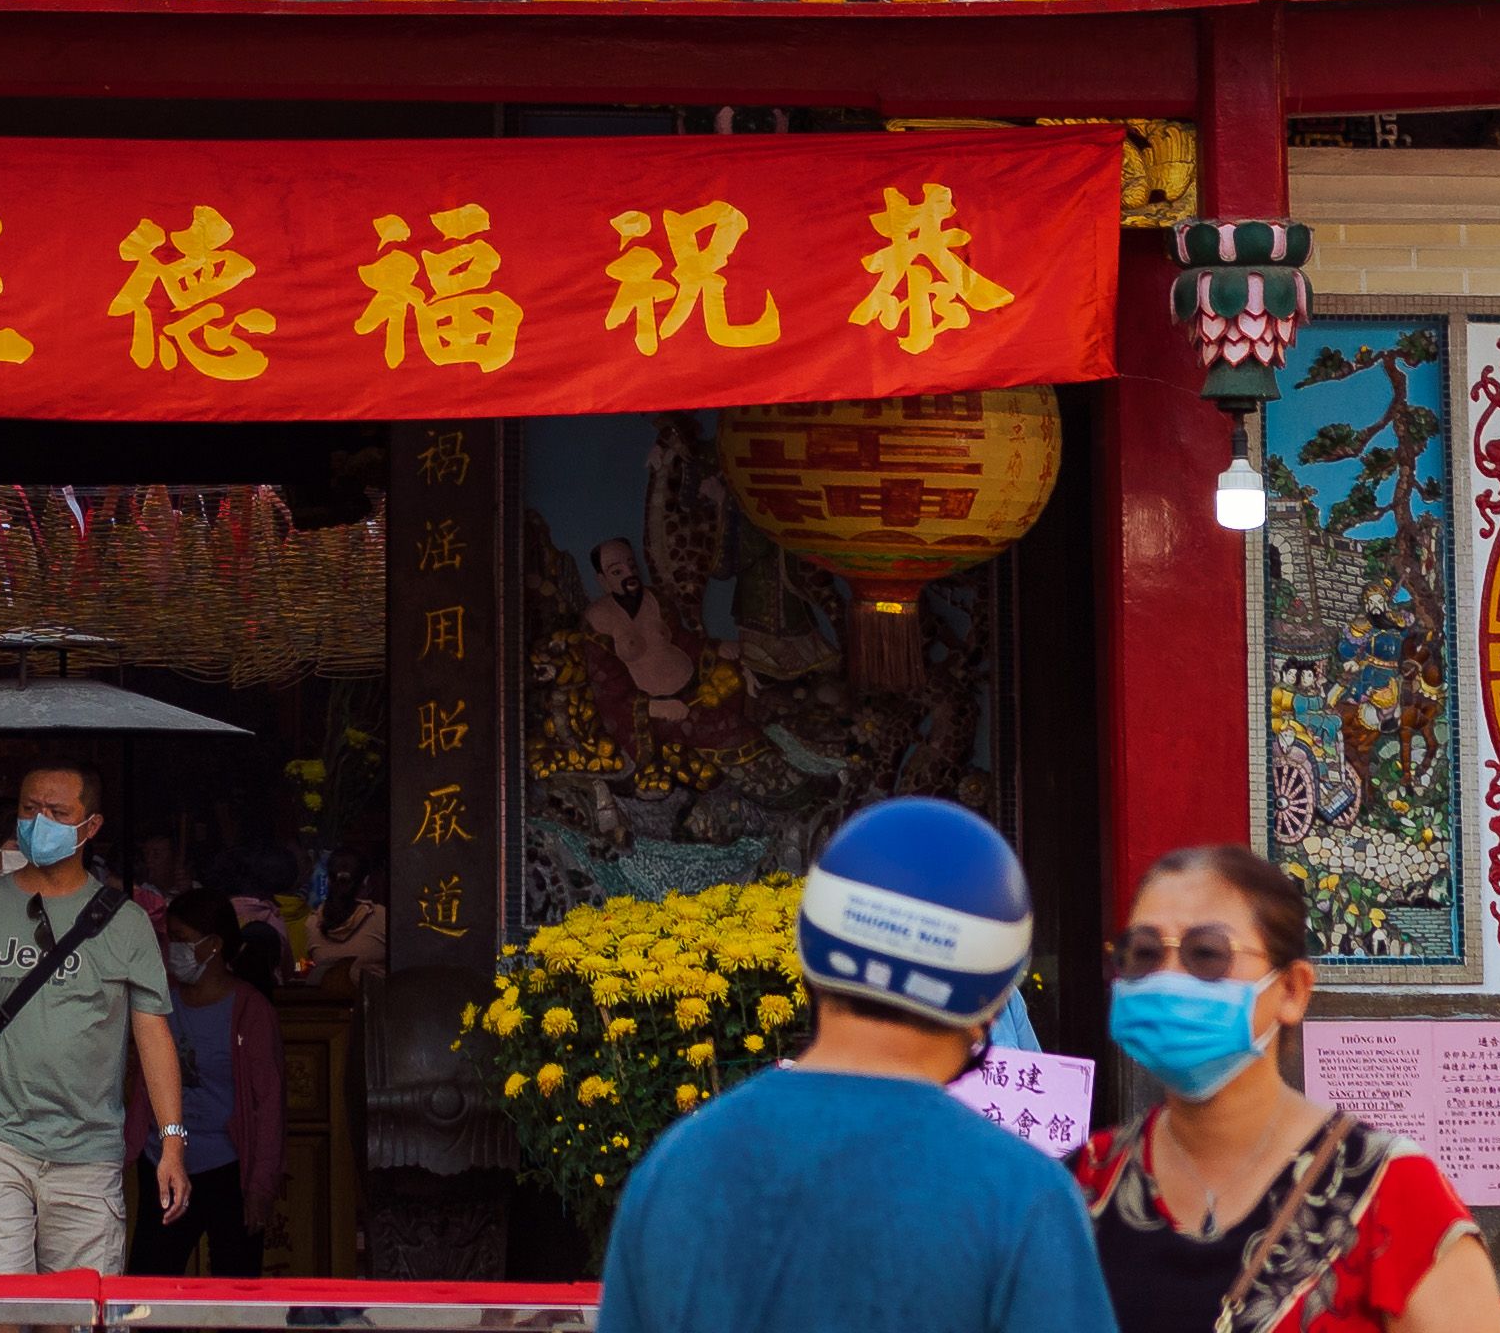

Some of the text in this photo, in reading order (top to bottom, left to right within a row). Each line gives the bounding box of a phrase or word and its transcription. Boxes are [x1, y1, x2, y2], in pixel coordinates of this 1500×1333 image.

[1340, 1035, 1396, 1044] THÔNG BÁO
[980, 1060, 1046, 1095] 福建
